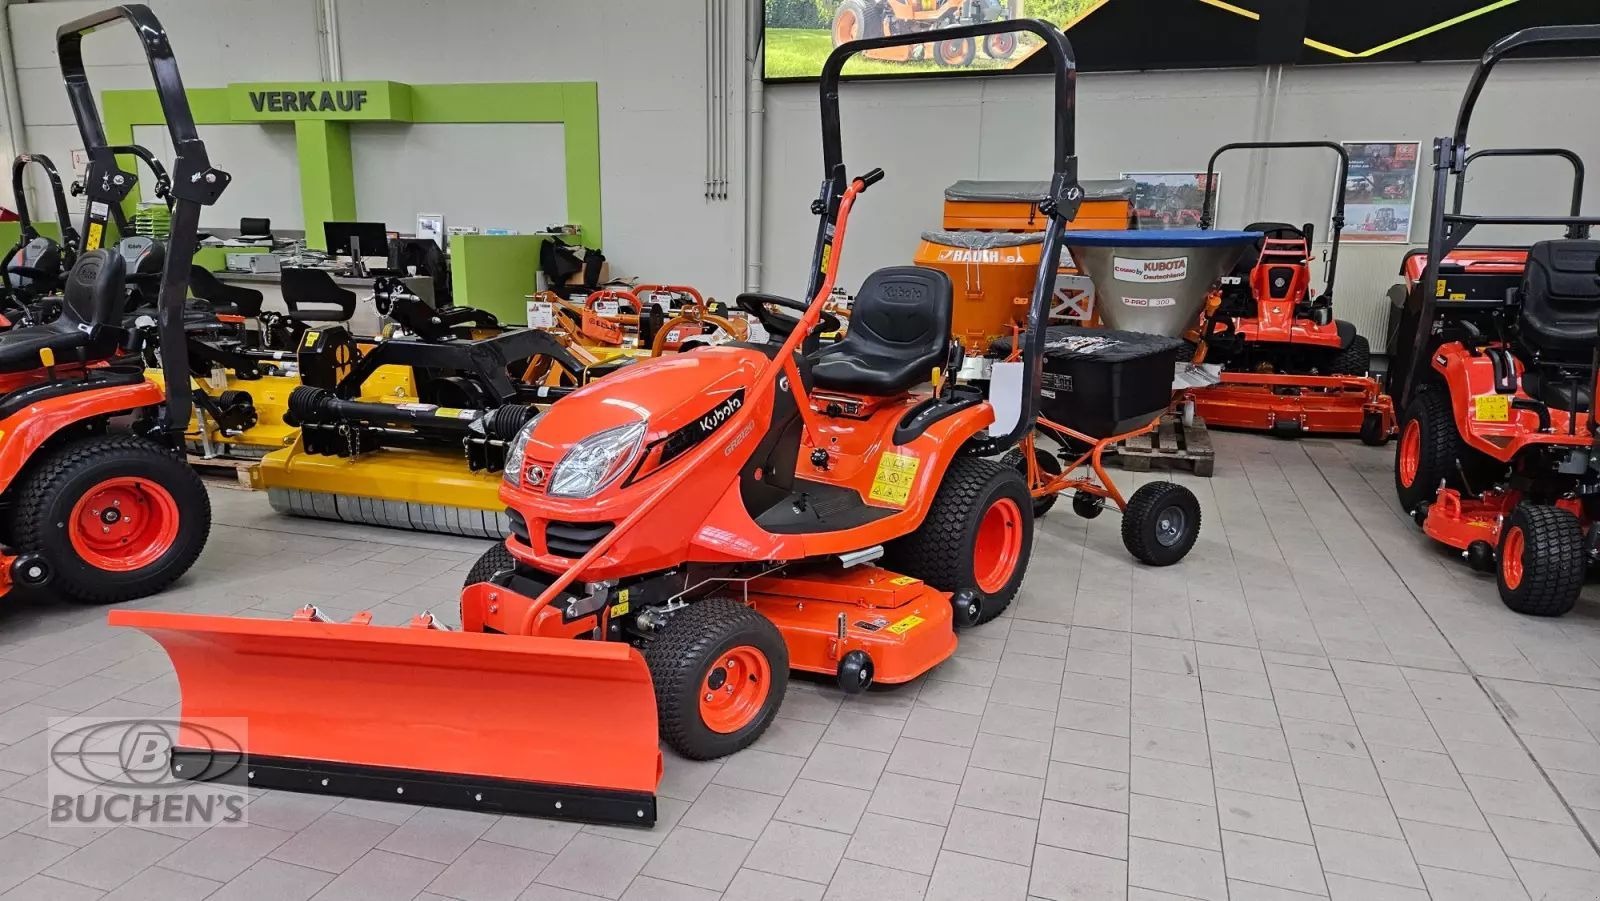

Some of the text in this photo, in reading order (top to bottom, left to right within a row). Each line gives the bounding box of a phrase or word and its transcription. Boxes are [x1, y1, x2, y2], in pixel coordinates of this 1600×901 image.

[248, 90, 368, 113] VERKAUF
[1135, 267, 1144, 276] by
[1143, 259, 1186, 272] KUBOTA
[1143, 270, 1185, 280] Deutschland
[699, 397, 742, 432] Kubota
